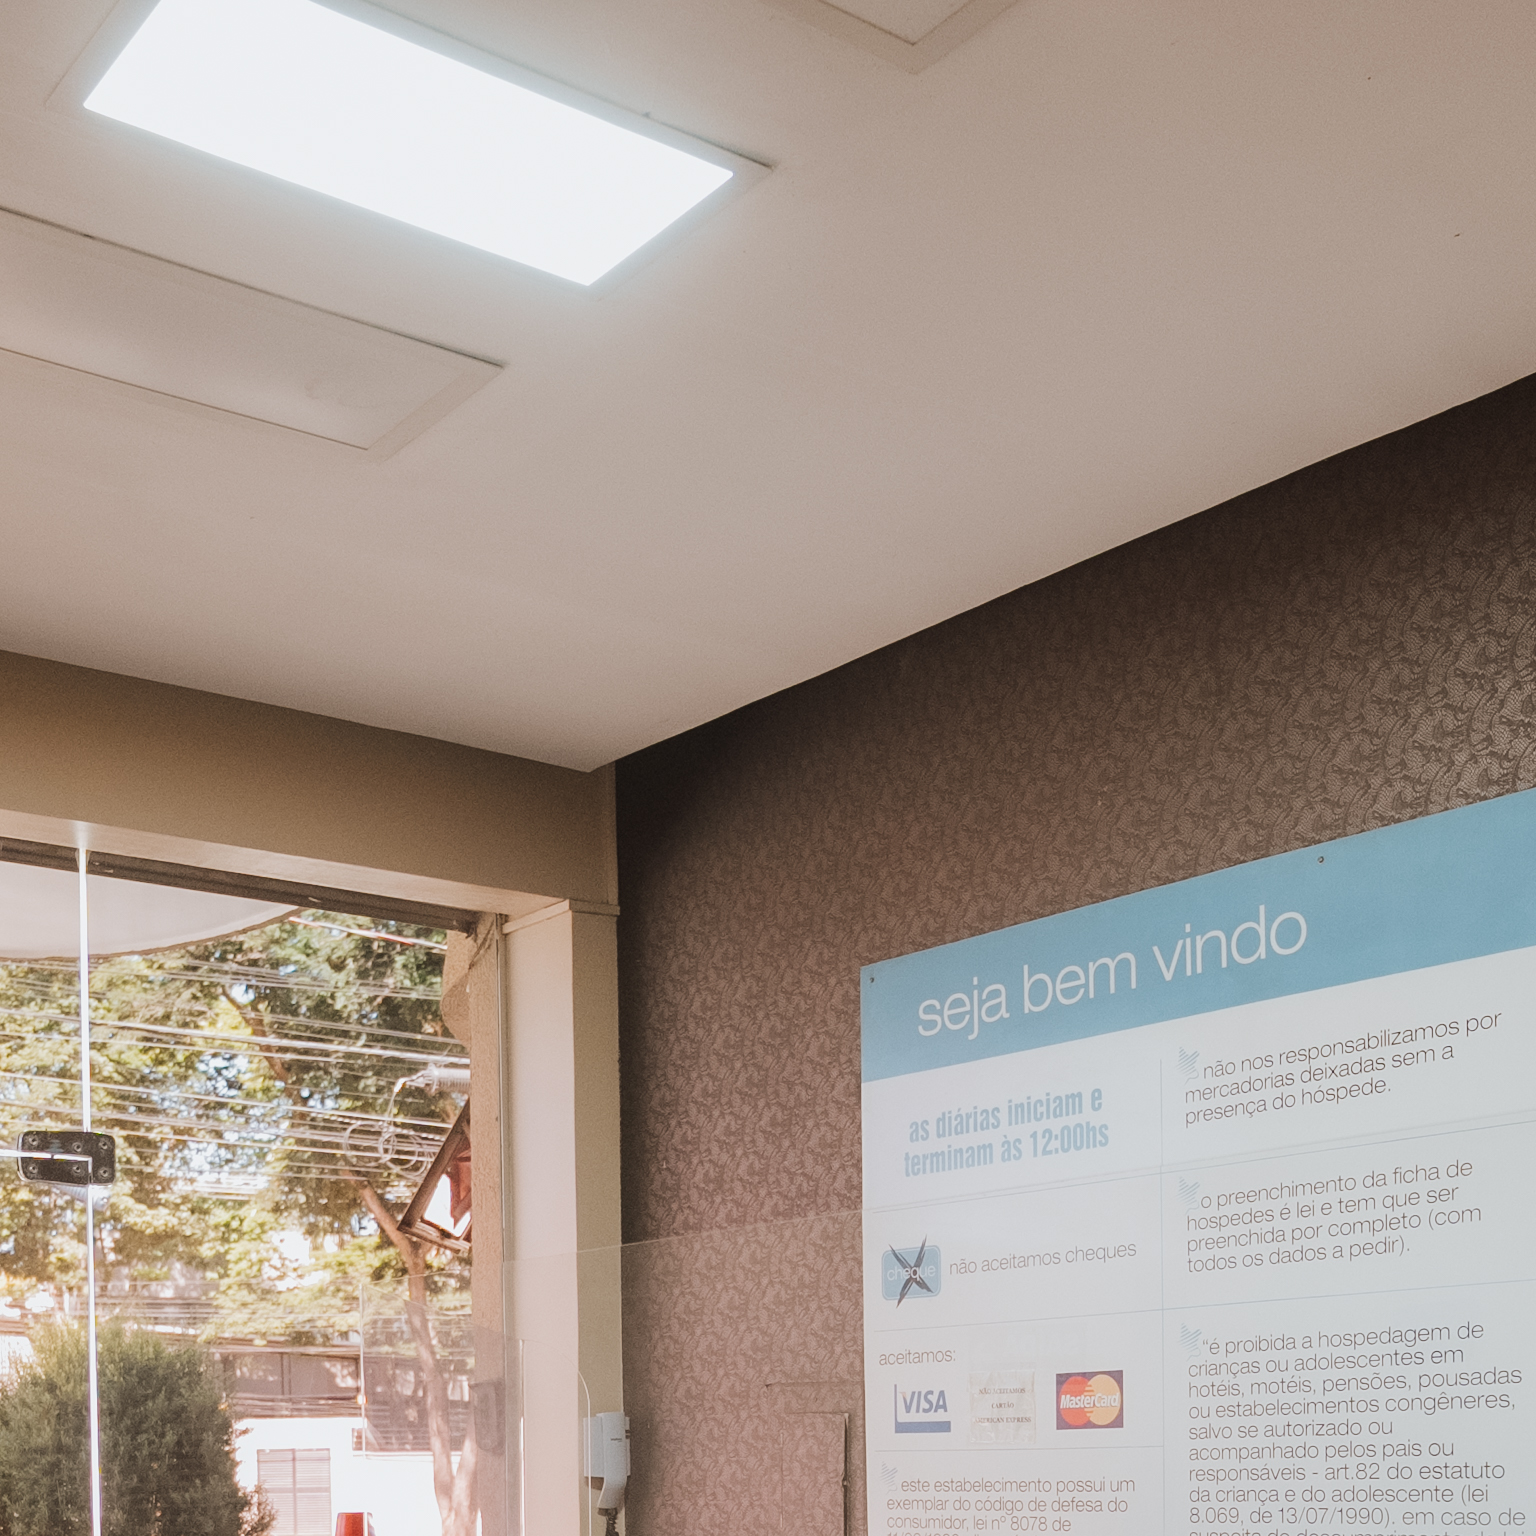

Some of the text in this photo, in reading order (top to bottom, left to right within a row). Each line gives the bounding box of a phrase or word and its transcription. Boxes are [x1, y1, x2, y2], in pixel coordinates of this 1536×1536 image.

[917, 904, 1308, 1041] seja bem vindo
[1203, 1012, 1502, 1079] não nos responsabilizamos por
[1185, 1045, 1455, 1104] mercadorias deixadas sem a
[909, 1087, 1103, 1143] as diárias iniciam e
[1185, 1077, 1391, 1129] presença do hóspede.
[903, 1120, 1109, 1178] terminam às 12:00hs
[1200, 1159, 1473, 1209] o preenchimento da ficha de
[1186, 1186, 1459, 1232] hospedes é lei e tem que ser
[1187, 1207, 1481, 1252] preenchida por completo (com
[949, 1243, 1137, 1275] não aceitamos cheques
[1187, 1235, 1410, 1273] todos os dados a pedir).
[886, 1263, 936, 1281] cheque
[1225, 1333, 1297, 1358] proibida
[1301, 1335, 1313, 1350] a
[1318, 1326, 1450, 1351] hospedagem
[1457, 1321, 1484, 1340] de
[878, 1349, 956, 1366] aceitamos:
[1188, 1349, 1464, 1379] crianças ou adolescentes em
[1188, 1366, 1523, 1398] hotéis, motéis, pensões, pousadas
[901, 1390, 948, 1414] VISA
[1059, 1392, 1120, 1410] MasterCard
[1188, 1391, 1515, 1420] ou estabelecimentos congêneres,
[1188, 1418, 1393, 1441] salvo se autorizado ou
[1188, 1438, 1454, 1465] acompanhado pelos pais ou
[900, 1476, 1136, 1496] este estabelecimento possui um
[1189, 1461, 1505, 1487] responsáveis art.82 do estatuto
[886, 1514, 1072, 1532] consumidor, lei nº 8078 de
[1189, 1506, 1526, 1528] 8.069, de 13/07/1990). em caso de
